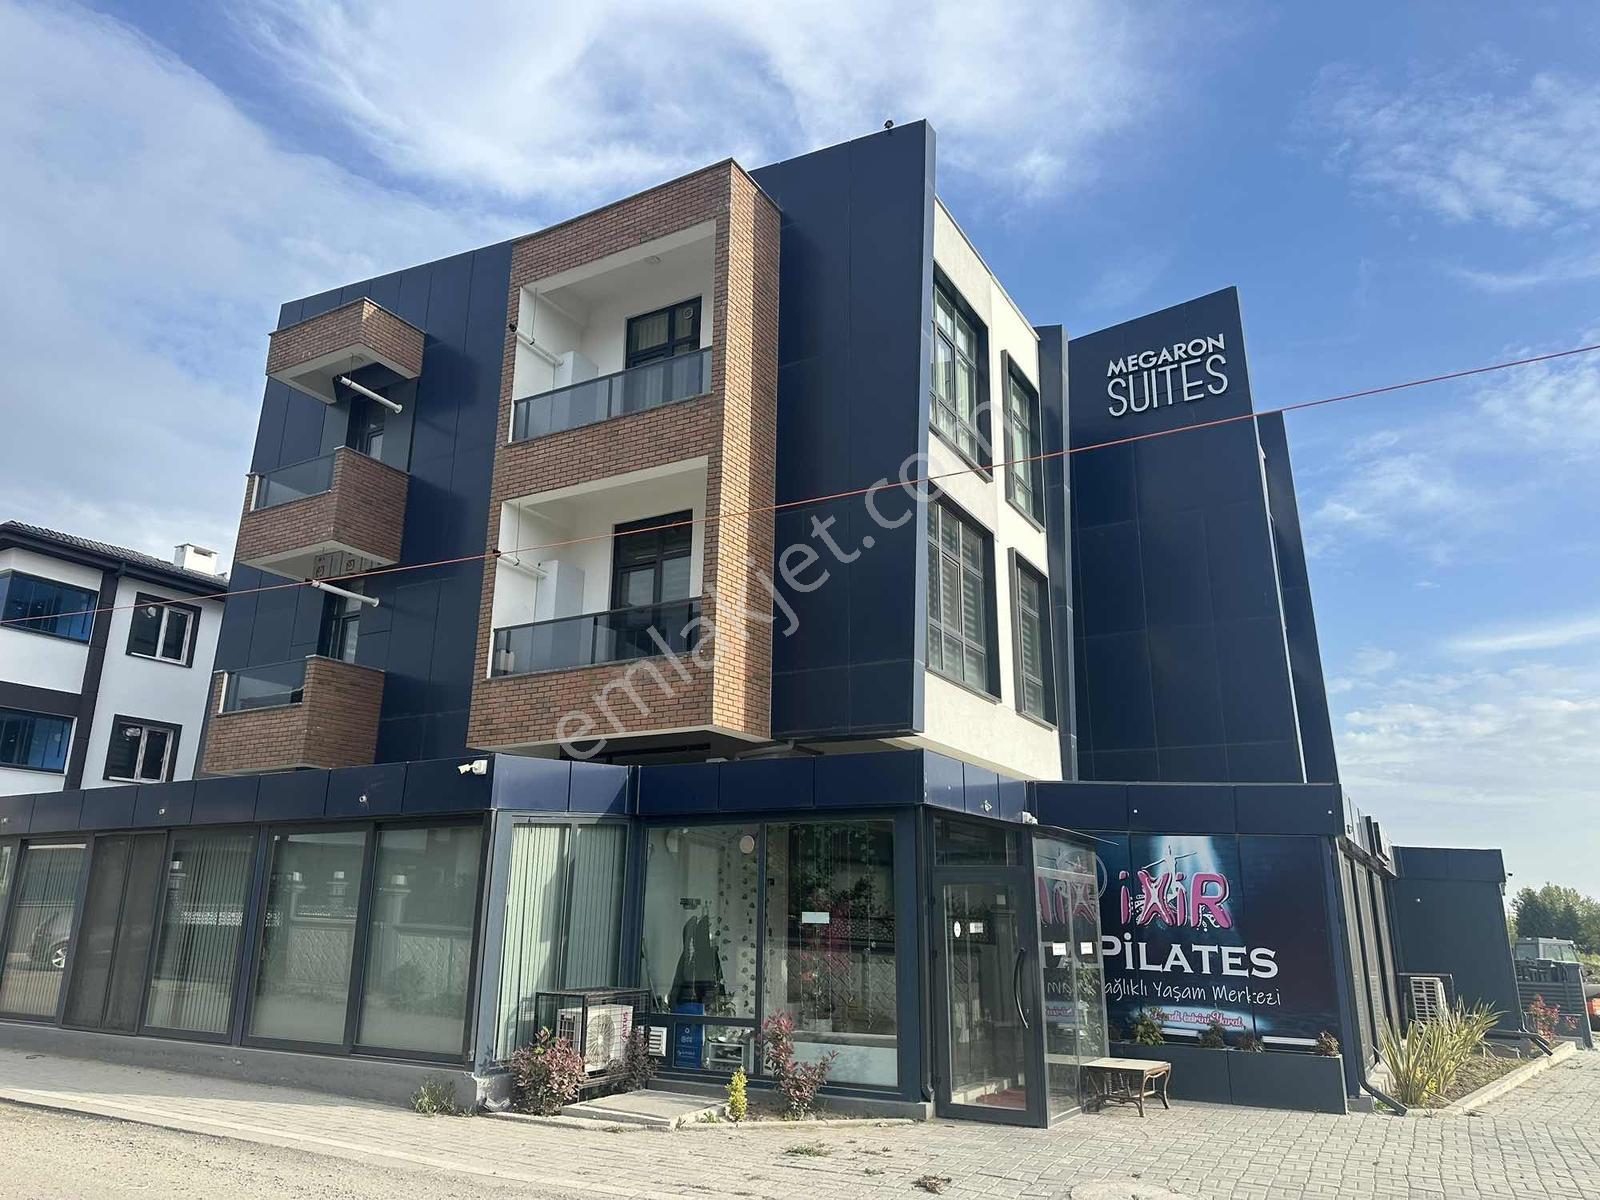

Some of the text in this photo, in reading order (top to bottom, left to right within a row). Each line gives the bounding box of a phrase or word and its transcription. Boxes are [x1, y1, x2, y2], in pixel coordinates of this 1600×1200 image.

[1106, 333, 1226, 378] MEGARON
[1106, 354, 1229, 418] SUITES
[1104, 977, 1281, 1006] ağlıklı Yaşam Merkezi
